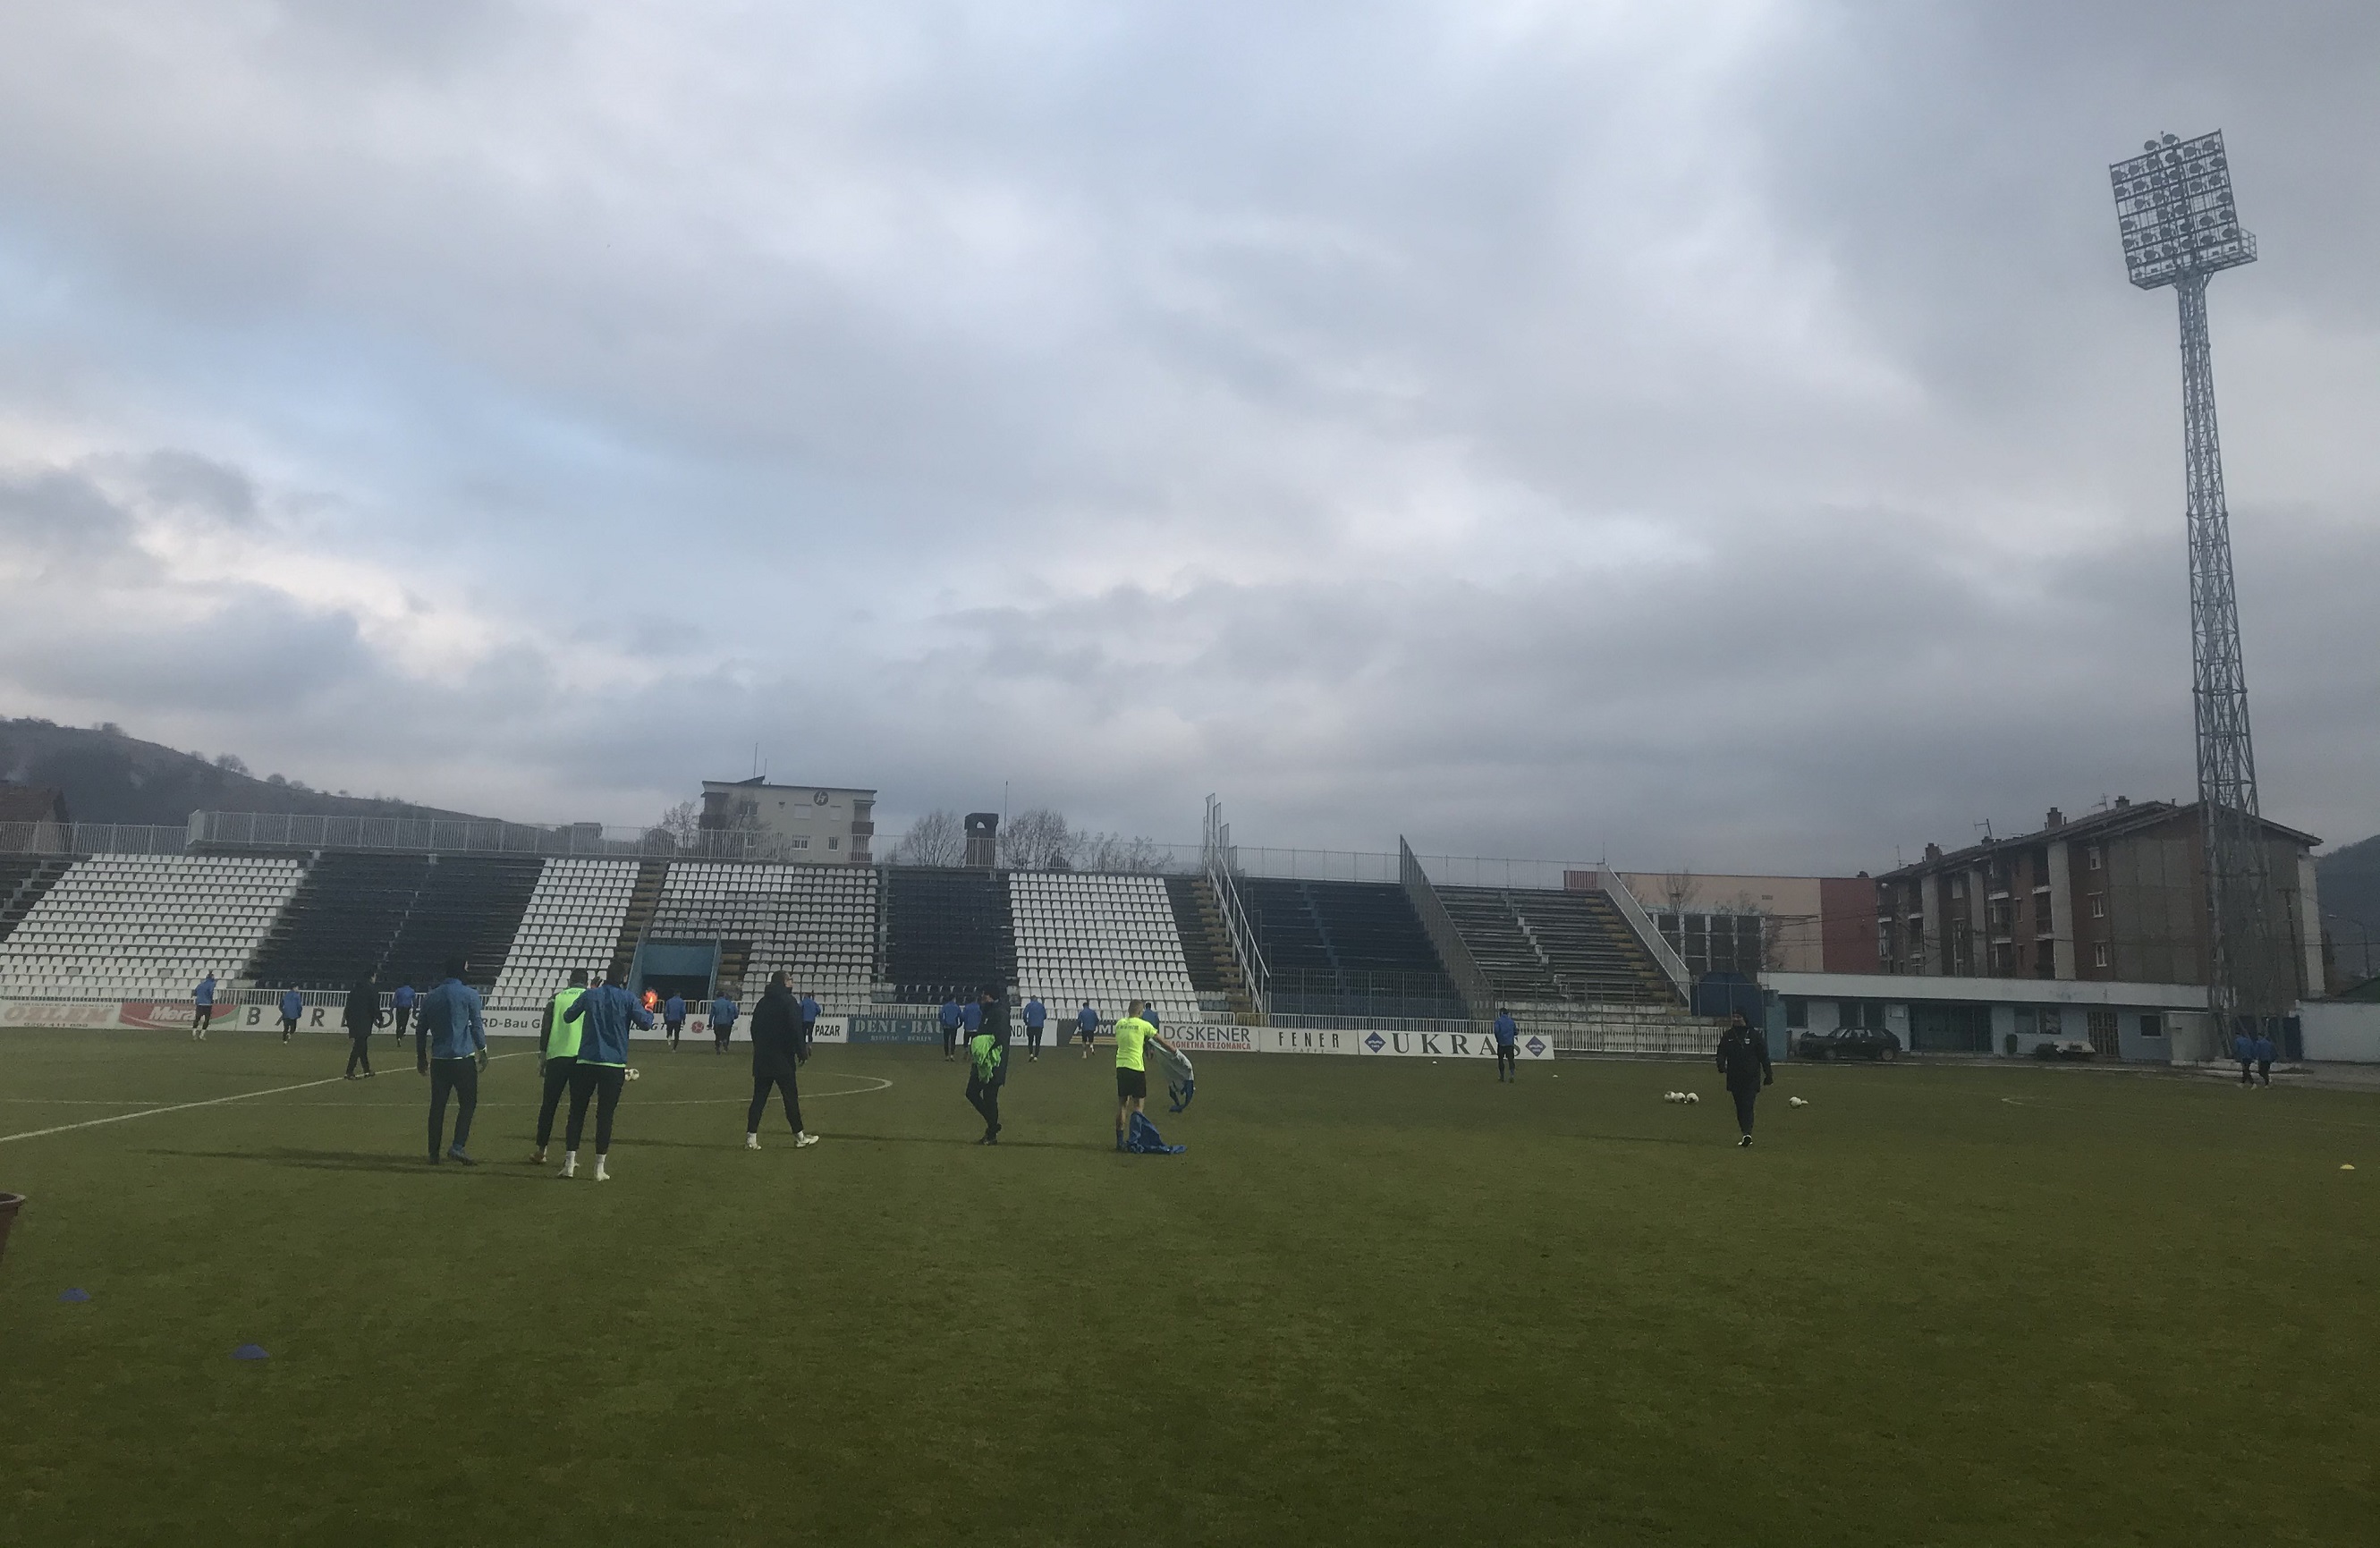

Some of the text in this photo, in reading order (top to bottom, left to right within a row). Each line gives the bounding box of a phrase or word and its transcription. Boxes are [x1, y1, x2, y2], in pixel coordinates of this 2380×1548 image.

[148, 1006, 197, 1020] Mera
[815, 1024, 841, 1036] PAZAR
[854, 1019, 897, 1033] DENI
[1169, 1040, 1251, 1050] AGNETNA REZONANCA
[1278, 1031, 1340, 1048] FENER
